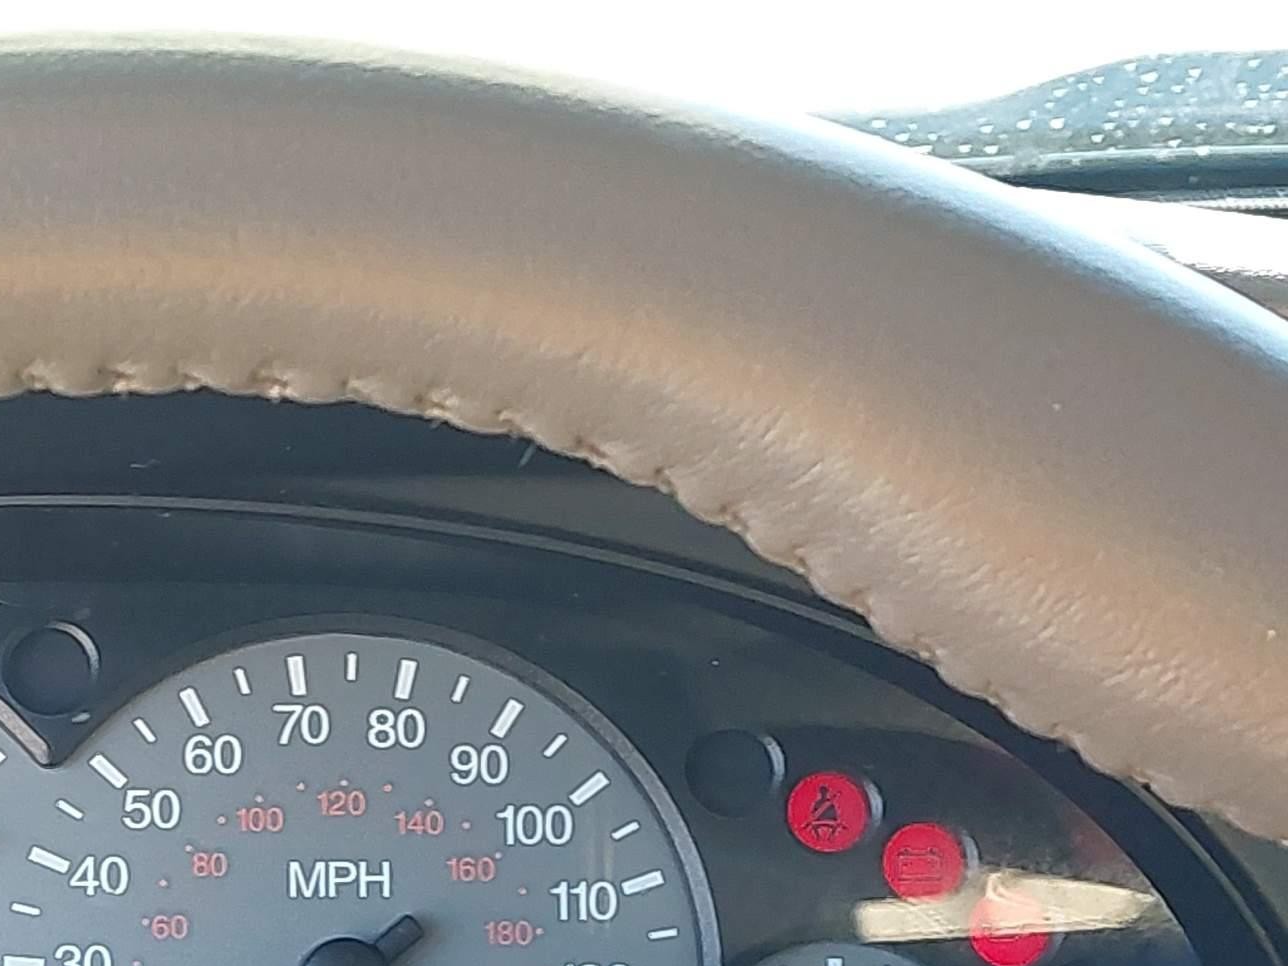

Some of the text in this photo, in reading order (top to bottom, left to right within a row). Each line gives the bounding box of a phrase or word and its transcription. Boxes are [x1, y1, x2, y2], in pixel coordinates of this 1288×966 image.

[273, 703, 329, 745] 70
[367, 709, 424, 749] 80
[184, 735, 242, 775] 60
[450, 744, 509, 785] 90
[122, 789, 180, 830] 50
[236, 807, 284, 833] 100
[317, 791, 366, 816] 120
[395, 810, 444, 836] 140
[496, 804, 573, 845] 100
[69, 855, 129, 896] 40
[192, 852, 228, 878] 80
[288, 861, 391, 898] MPH
[446, 857, 496, 882] 160
[550, 880, 617, 921] 110
[151, 916, 188, 939] 60
[484, 921, 532, 946] 180
